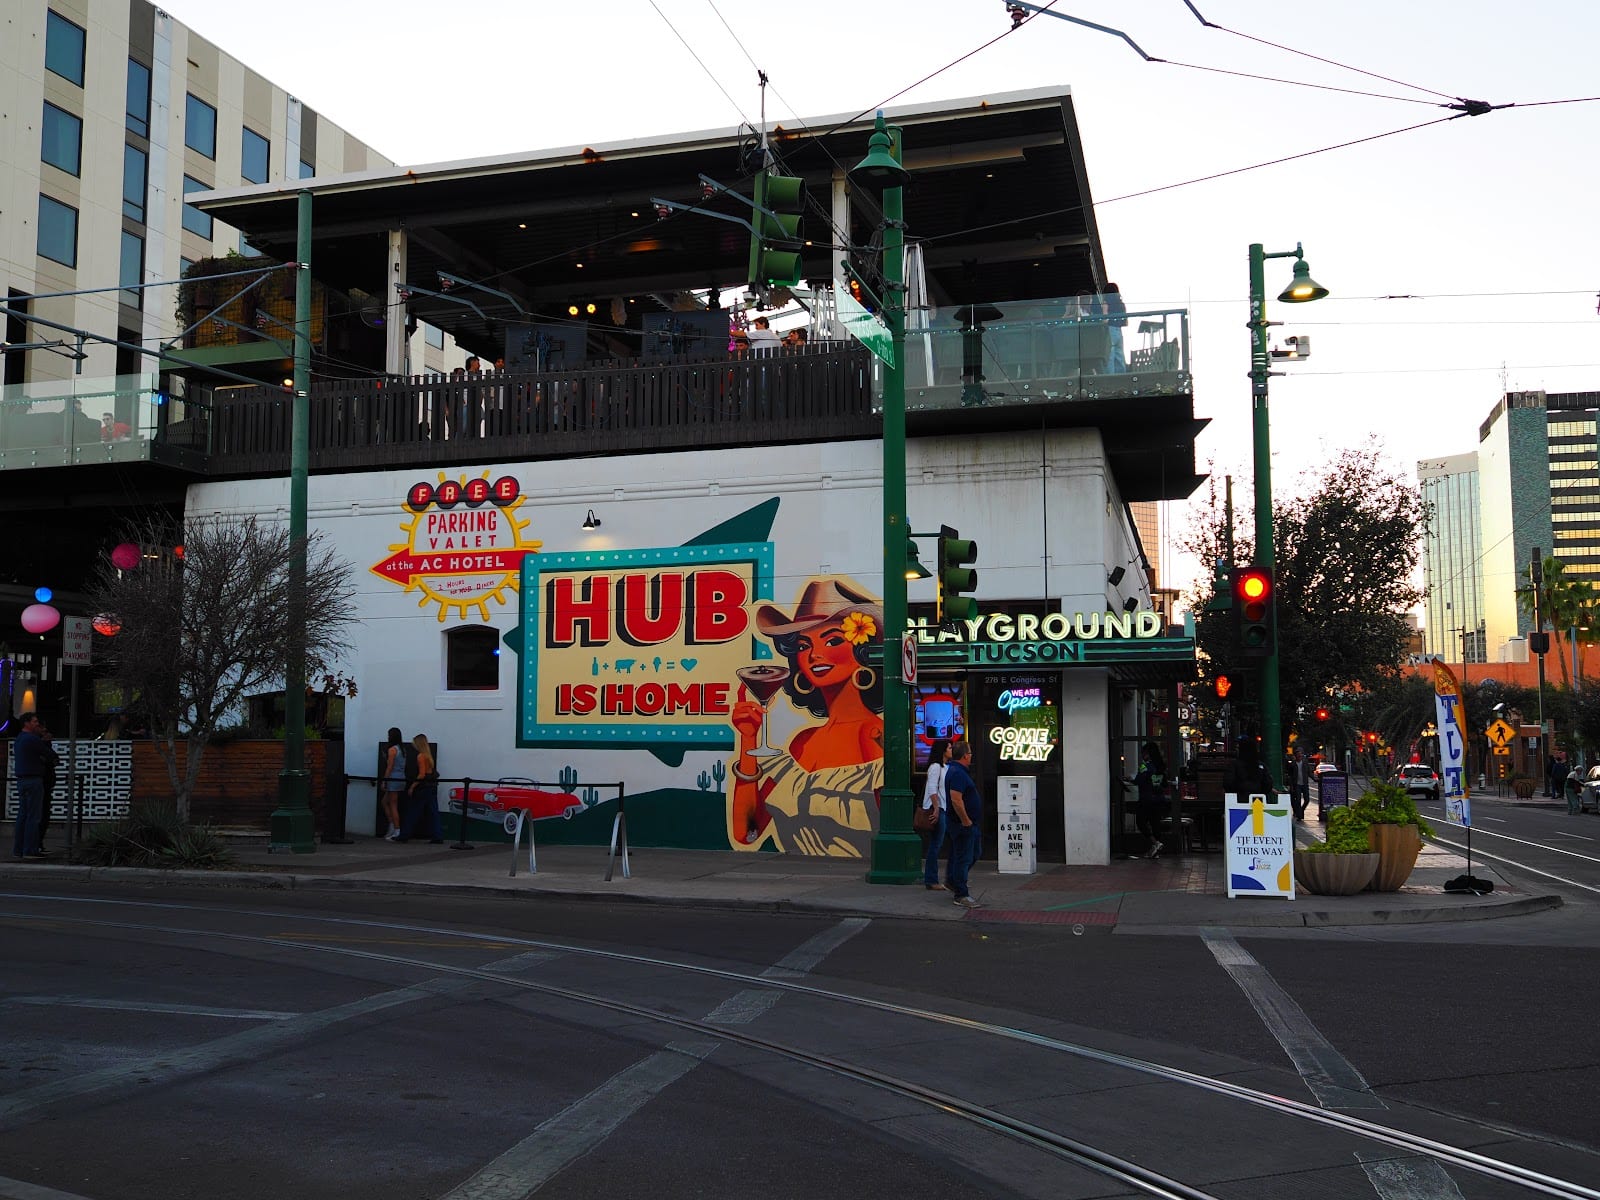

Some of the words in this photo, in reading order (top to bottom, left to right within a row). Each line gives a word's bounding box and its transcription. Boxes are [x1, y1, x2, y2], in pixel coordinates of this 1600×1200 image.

[418, 482, 512, 502] FREE
[428, 510, 497, 534] PARKING
[429, 534, 497, 549] VALET
[386, 562, 396, 571] at
[399, 561, 414, 570] the
[420, 558, 443, 571] AC
[450, 555, 505, 570] HOTEL
[545, 570, 749, 649] HUB
[970, 643, 1080, 662] TUCSON
[1010, 675, 1046, 685] Congress
[555, 683, 598, 715] IS
[600, 682, 730, 716] HOME
[1011, 689, 1024, 697] WE
[1025, 688, 1041, 696] ARE
[998, 690, 1041, 716] Open
[989, 726, 1050, 745] COME
[1000, 743, 1055, 761] PLAY
[1007, 823, 1013, 831] S
[1015, 823, 1030, 831] 5TH
[1008, 833, 1023, 841] AVE
[1236, 836, 1251, 846] TJF
[1253, 836, 1284, 845] EVENT
[1237, 847, 1259, 855] THIS
[1261, 847, 1284, 856] WAY
